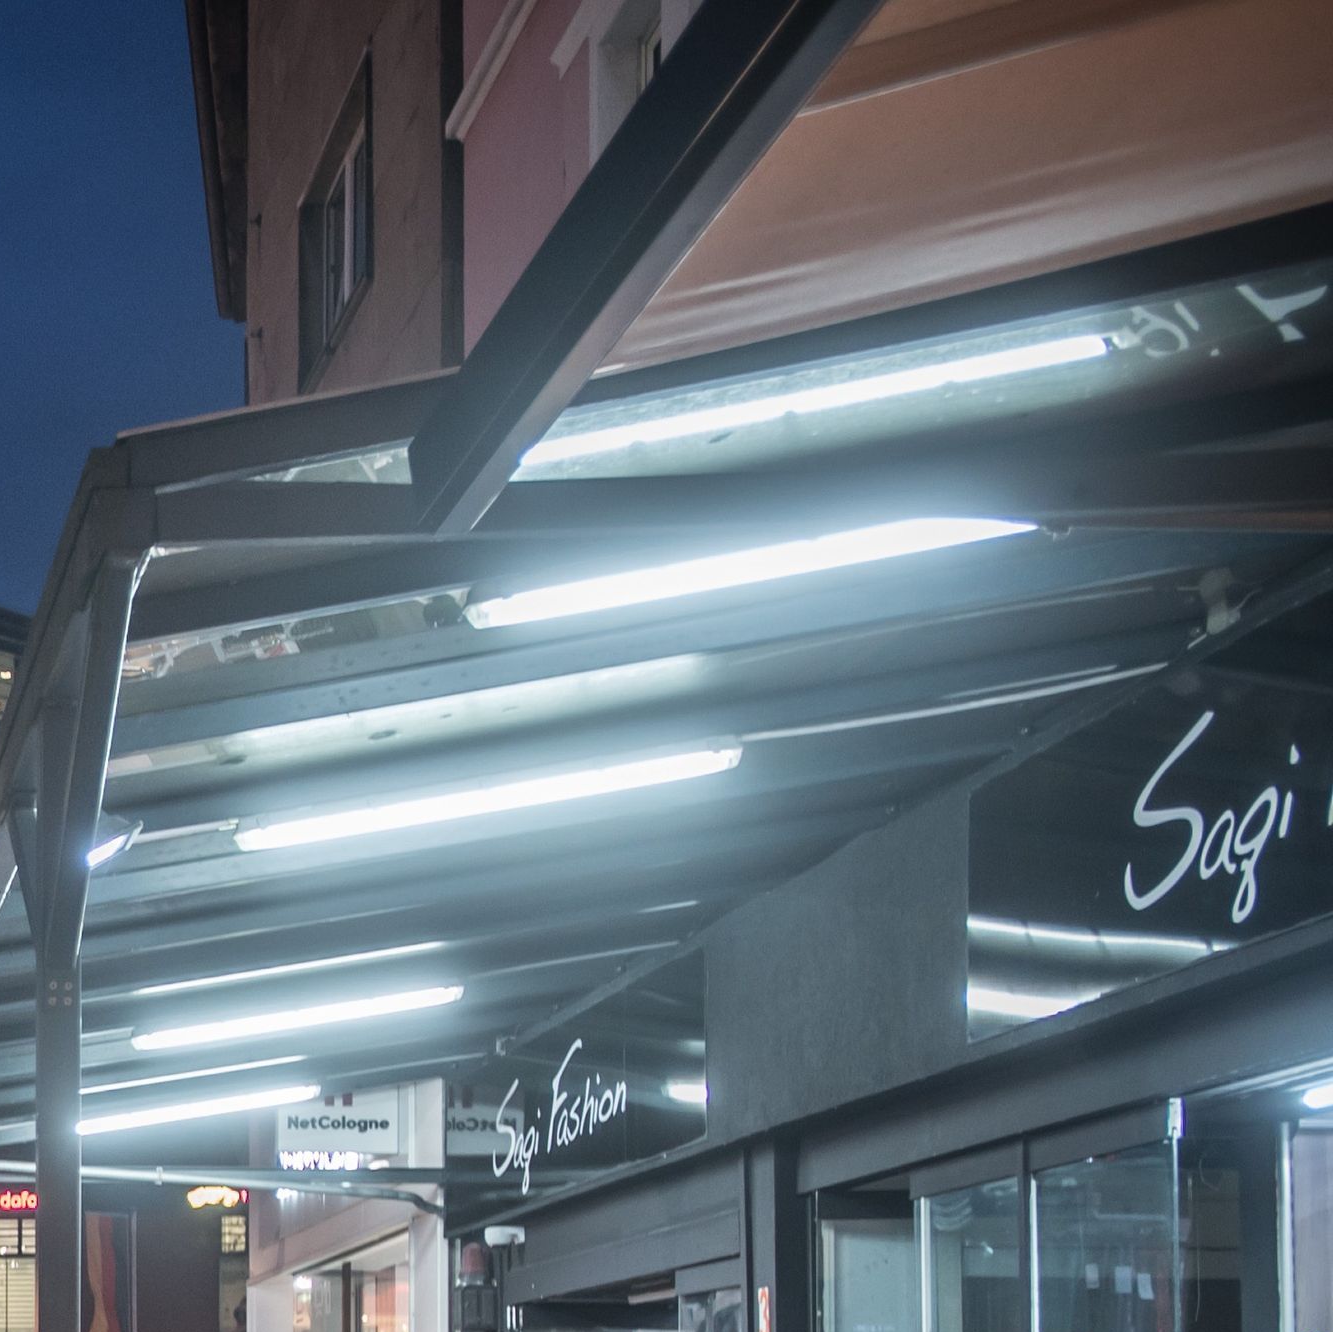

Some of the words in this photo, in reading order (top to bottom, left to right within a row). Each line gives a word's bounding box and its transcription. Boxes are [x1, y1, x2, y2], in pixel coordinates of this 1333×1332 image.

[1124, 710, 1300, 923] Sagi
[287, 1115, 390, 1133] NetCologne
[493, 1078, 541, 1195] Sagi
[547, 1038, 626, 1154] Fashion
